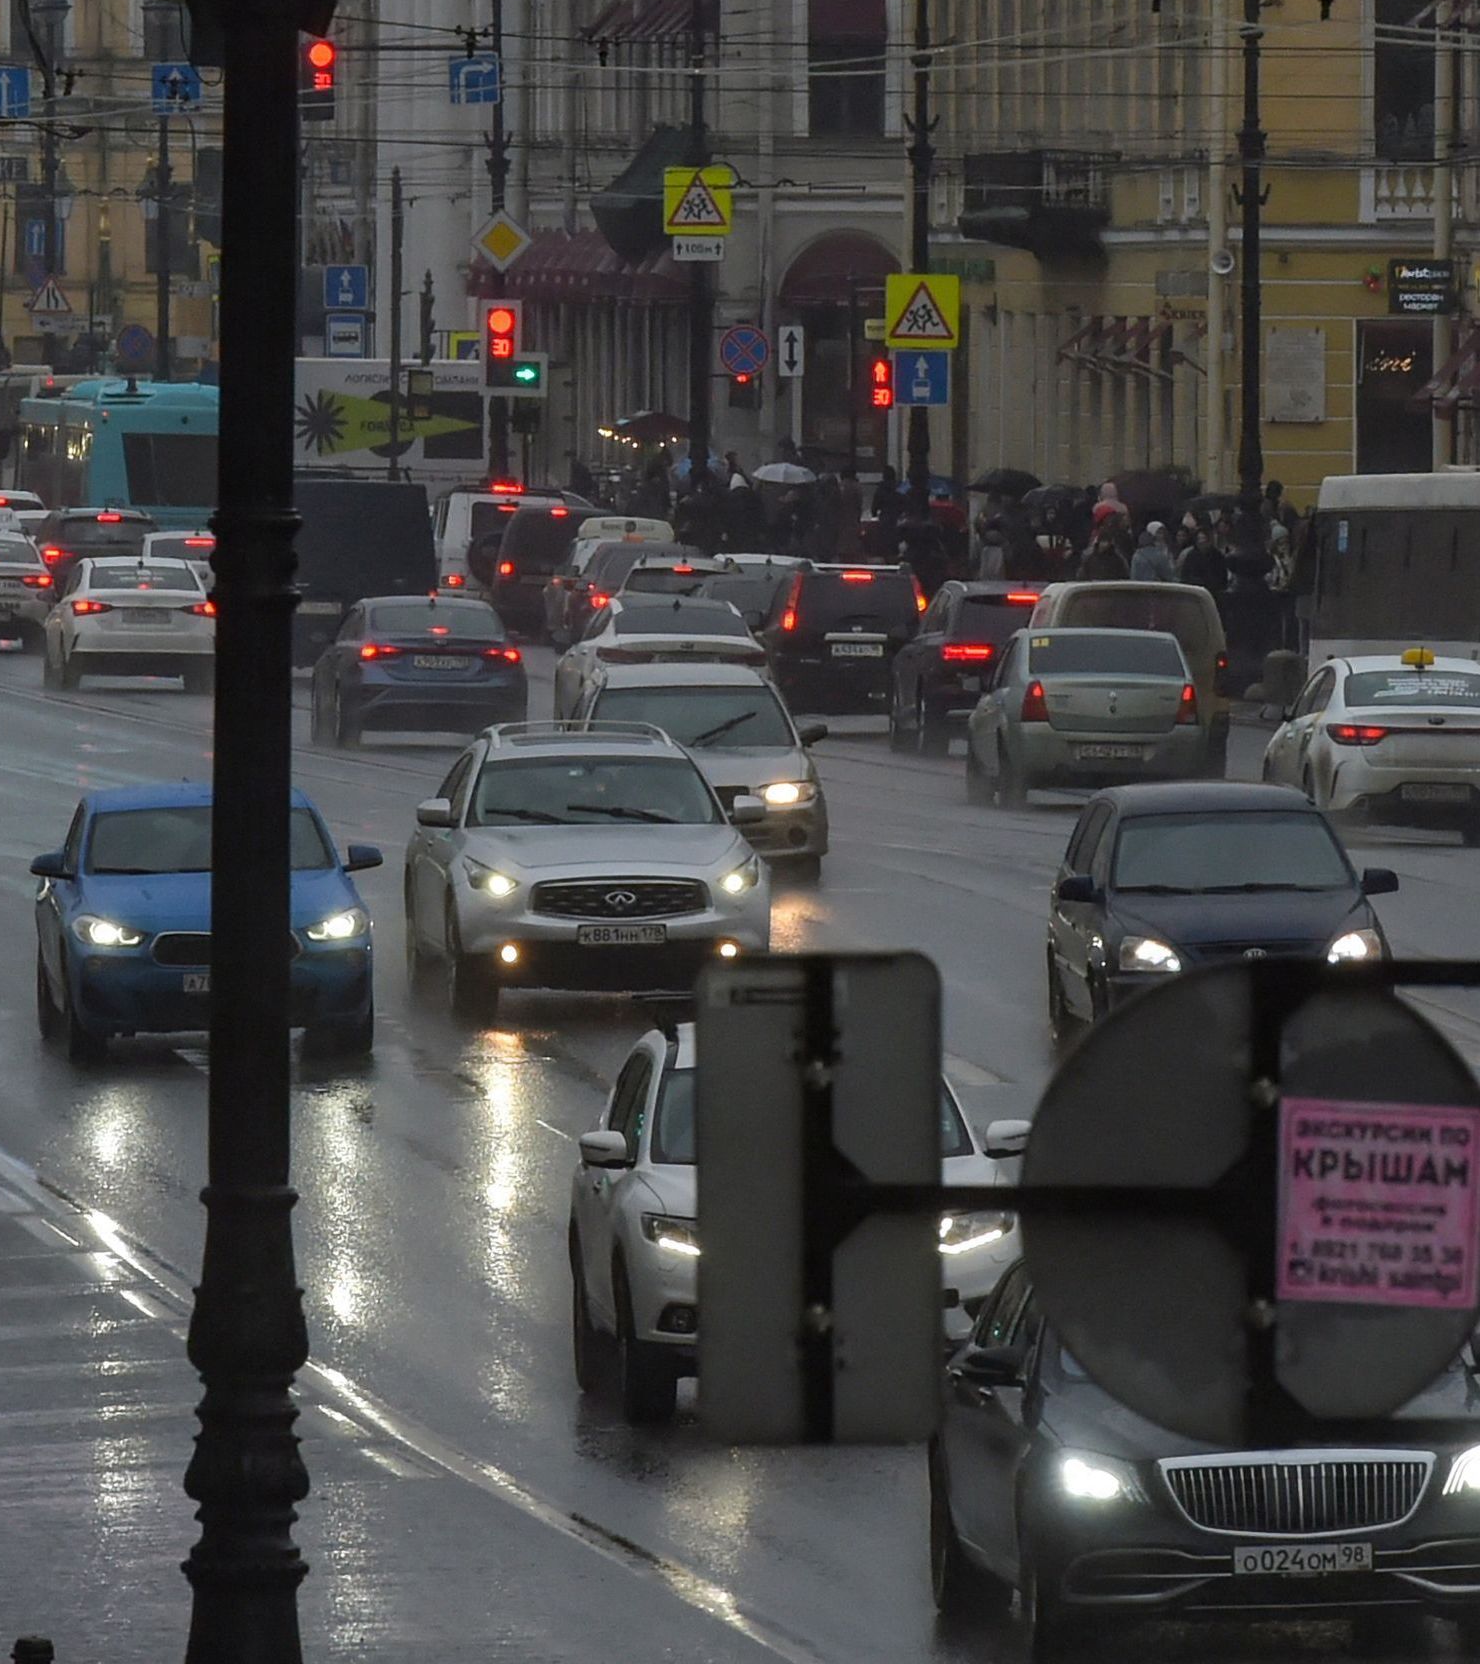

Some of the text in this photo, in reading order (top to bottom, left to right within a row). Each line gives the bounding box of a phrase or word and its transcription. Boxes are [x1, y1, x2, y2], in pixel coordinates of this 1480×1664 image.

[492, 338, 510, 356] 30
[873, 388, 890, 405] 30
[1297, 1119, 1469, 1146] ЭКСКУРСИИ ПО
[1294, 1148, 1469, 1187] КРЫШАМ
